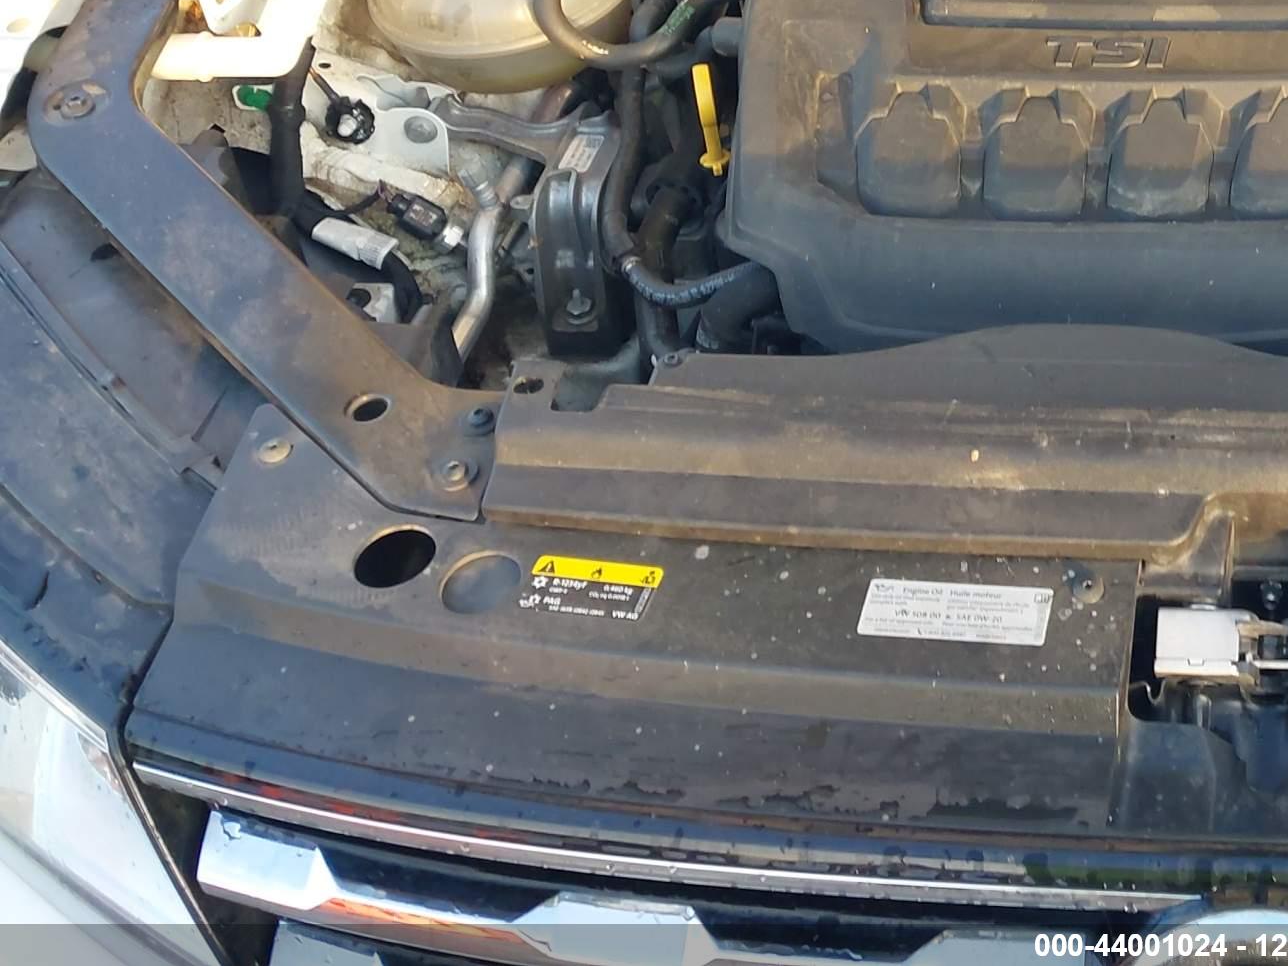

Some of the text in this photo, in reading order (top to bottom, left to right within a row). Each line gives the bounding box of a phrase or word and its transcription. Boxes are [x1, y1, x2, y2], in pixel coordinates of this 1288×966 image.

[1046, 35, 1171, 68] TSI
[902, 586, 943, 595] Engine Oil
[949, 589, 971, 598] Huile
[971, 591, 1003, 599] moteur
[612, 609, 639, 621] VW AG
[894, 609, 909, 618] VW
